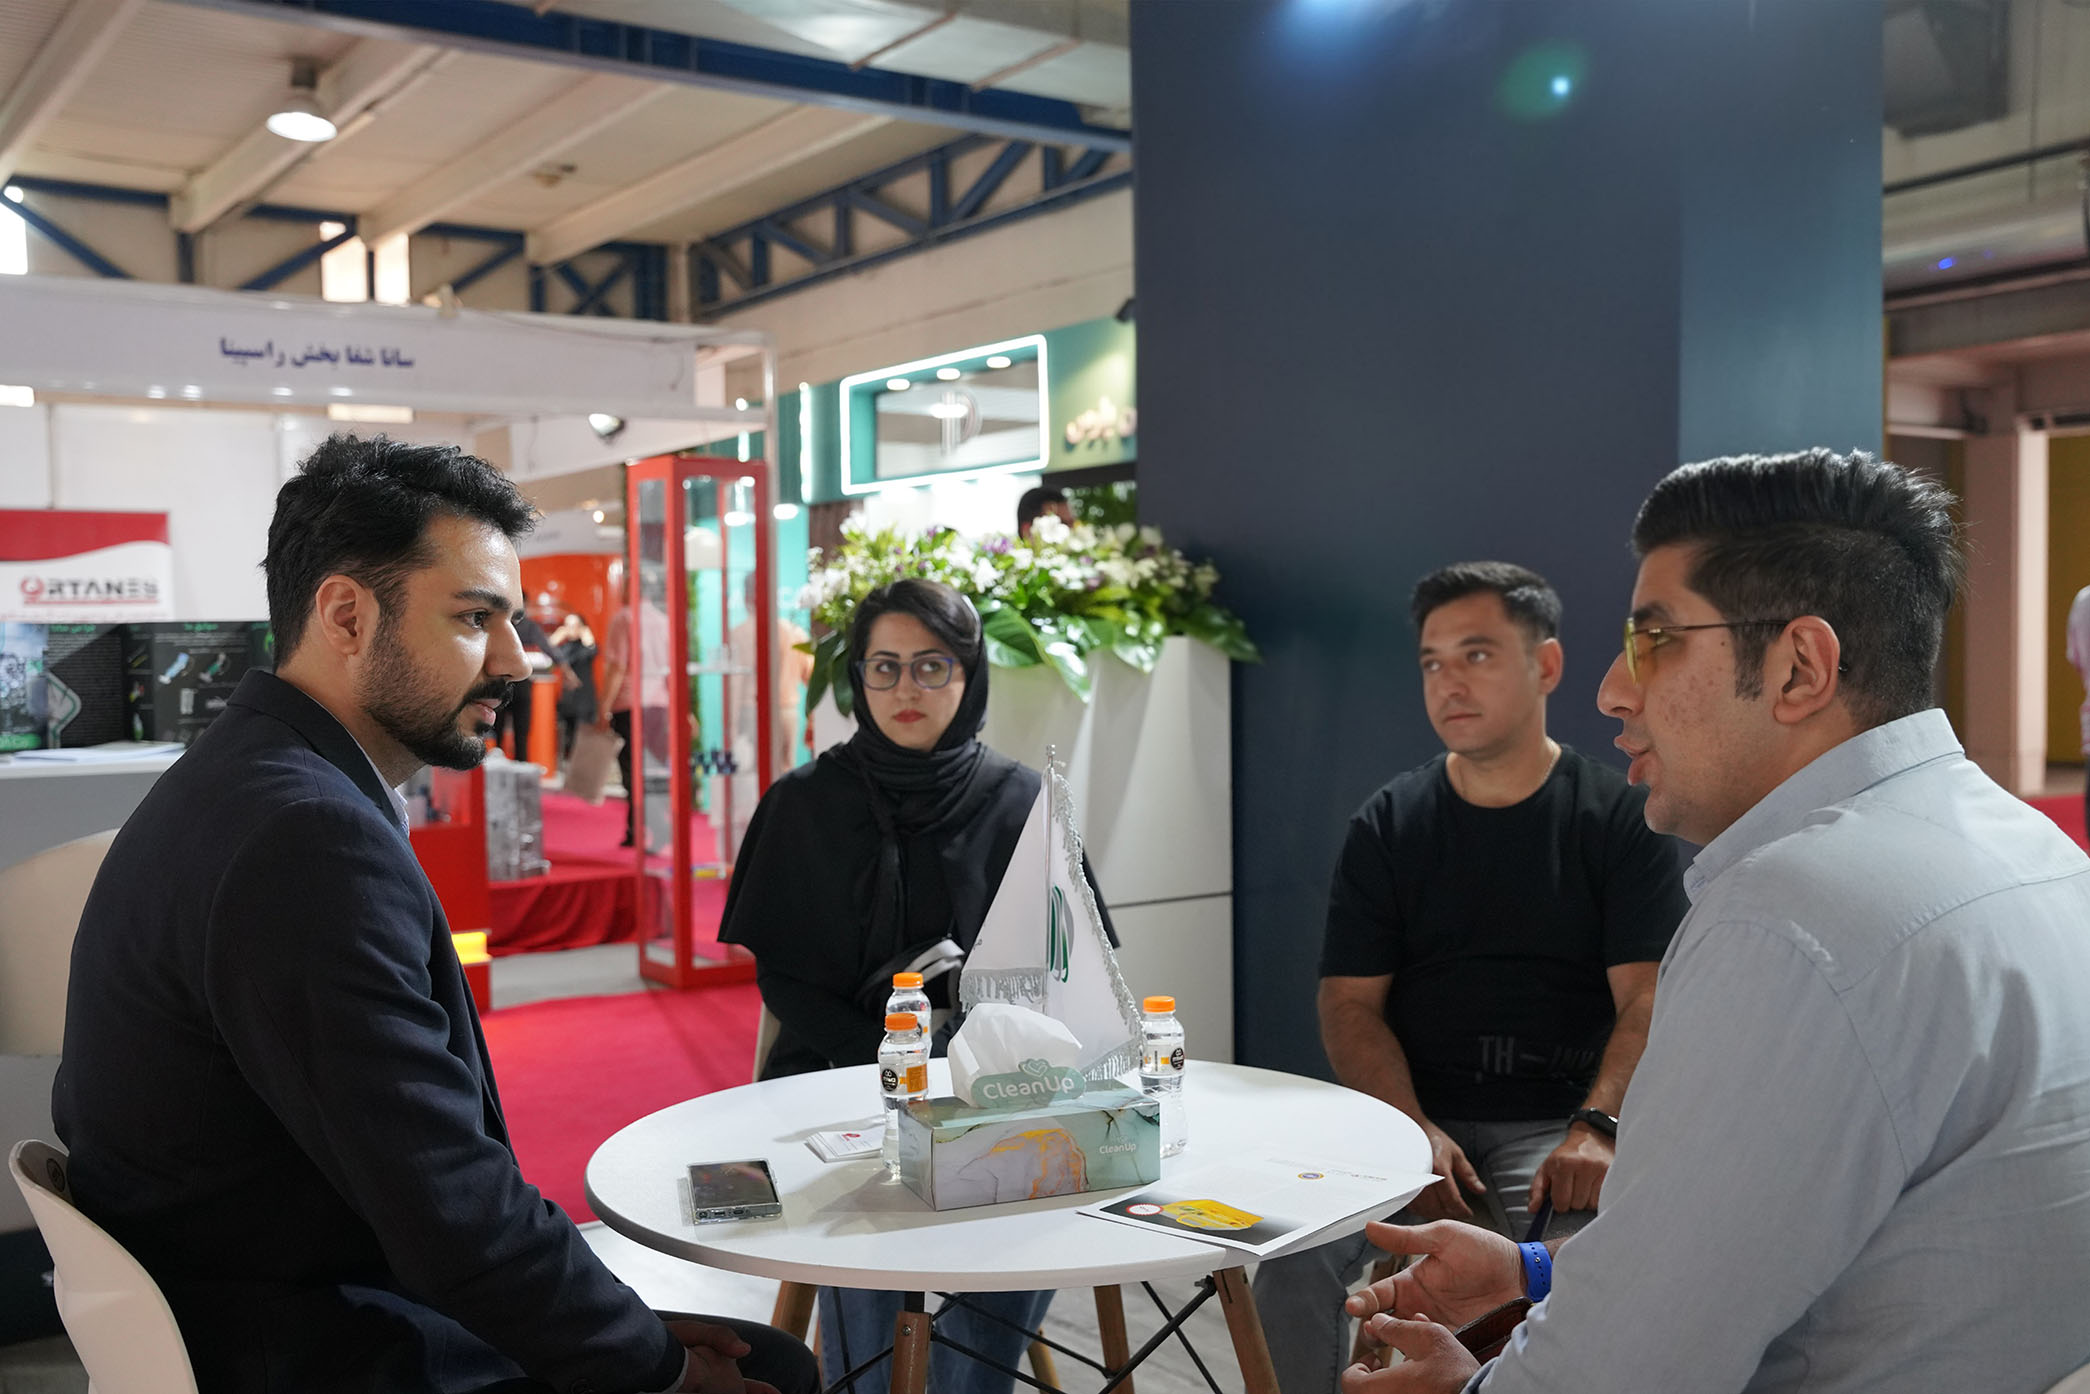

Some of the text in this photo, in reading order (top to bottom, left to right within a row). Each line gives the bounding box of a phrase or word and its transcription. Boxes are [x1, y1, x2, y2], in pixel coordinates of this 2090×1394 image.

[291, 345, 339, 370] بخش
[346, 345, 375, 366] شفا
[381, 348, 414, 367] سانا
[983, 1076, 1075, 1099] CleanUp
[1099, 1142, 1136, 1154] CleanUp
